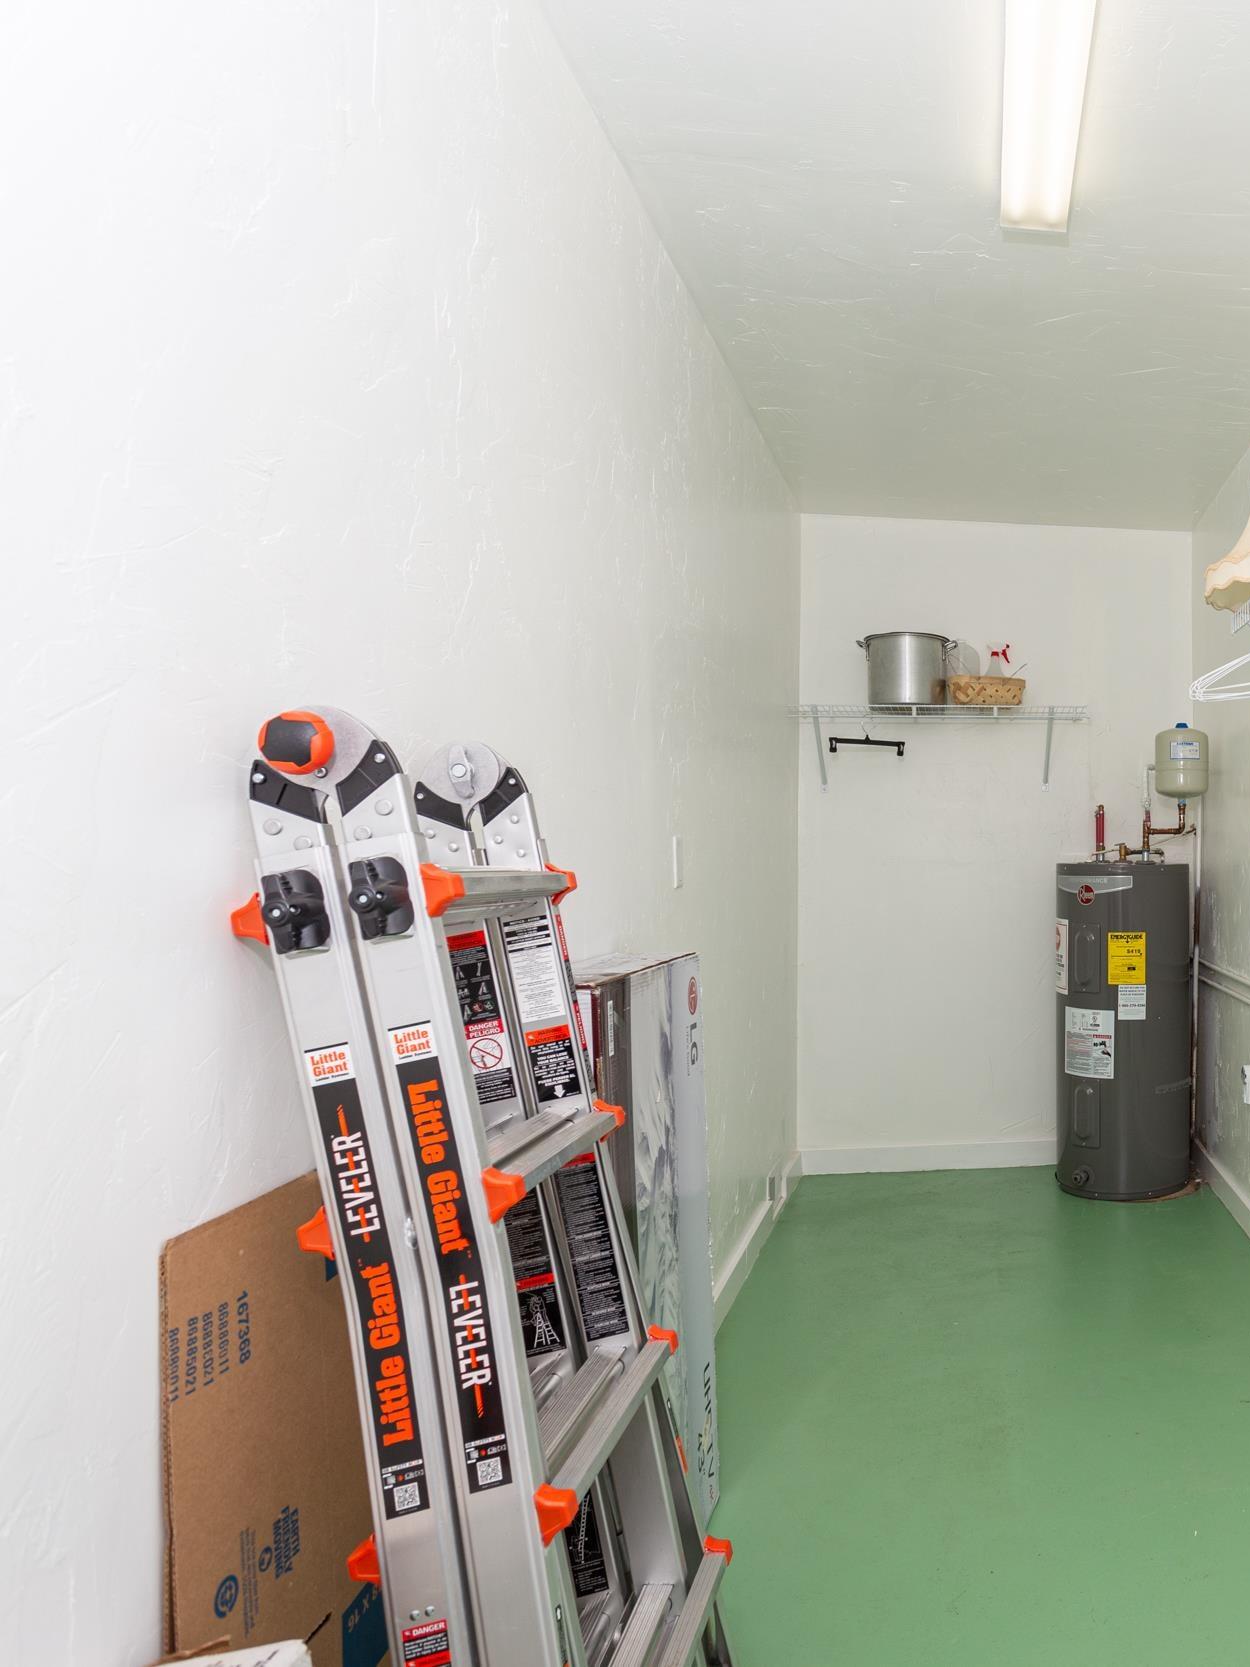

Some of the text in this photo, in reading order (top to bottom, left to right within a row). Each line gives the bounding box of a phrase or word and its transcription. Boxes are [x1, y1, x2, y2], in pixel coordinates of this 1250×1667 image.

[394, 1029, 429, 1043] Little
[396, 1040, 432, 1055] Giant
[468, 1020, 499, 1031] DANGER
[470, 1027, 501, 1038] PELIGRO
[690, 1022, 698, 1066] LG
[310, 1051, 346, 1066] Little
[313, 1061, 349, 1077] Giant
[408, 1080, 449, 1165] Little
[331, 1131, 381, 1236] LEVELER
[426, 1170, 469, 1255] Giant
[236, 1290, 252, 1364] 167368
[359, 1261, 400, 1350] Giant
[449, 1280, 492, 1390] LEVELER
[375, 1354, 414, 1447] Little
[272, 1518, 283, 1579] MOVING
[280, 1505, 293, 1573] FRIENDLY
[290, 1507, 300, 1555] EARTH
[412, 1621, 446, 1636] DANGER
